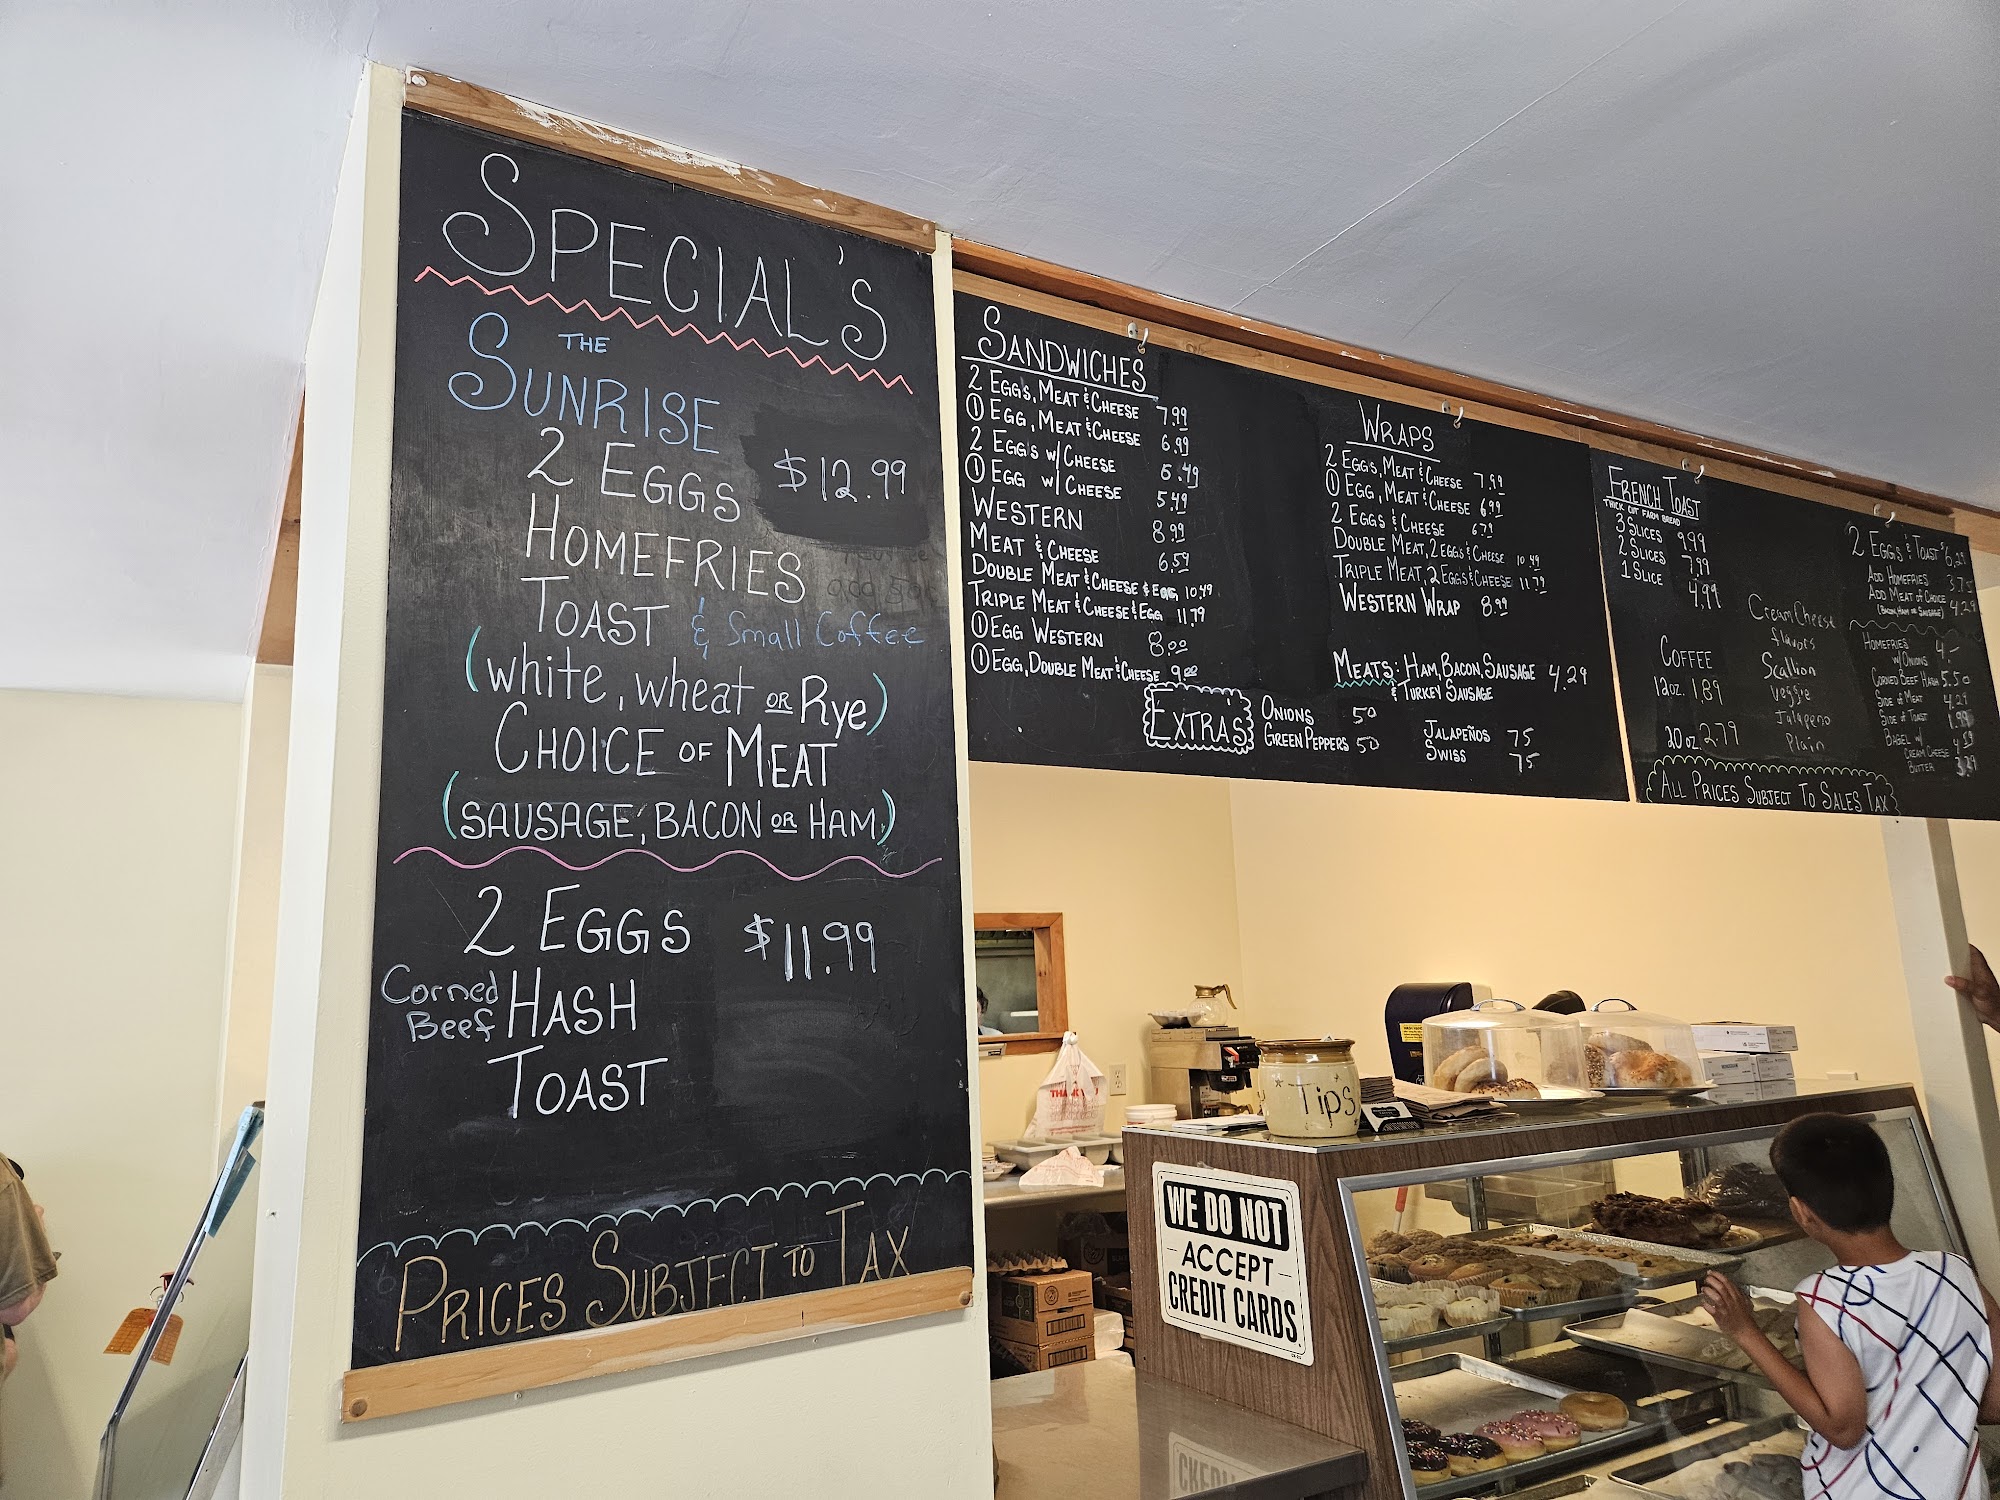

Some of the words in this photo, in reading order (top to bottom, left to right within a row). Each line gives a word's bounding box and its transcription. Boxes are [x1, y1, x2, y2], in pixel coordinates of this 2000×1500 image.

[443, 153, 887, 361] SPECIAL'S
[558, 333, 610, 353] THE
[978, 306, 1146, 393] SANDWICHES
[448, 312, 721, 454] SUNRISE
[968, 364, 982, 390] 2
[1039, 379, 1080, 407] MEAT
[1091, 391, 1139, 419] CHEESE
[1156, 406, 1188, 431] 7.99
[1039, 409, 1082, 436] MEAT
[1092, 421, 1141, 447] CHEESE
[1162, 434, 1188, 456] 6.99
[1358, 399, 1434, 452] WRAPS
[970, 425, 982, 451] 2
[1064, 444, 1116, 473] CHEESE
[1325, 444, 1337, 467] 2
[1383, 455, 1414, 481] MEAT
[1426, 465, 1463, 490] CHEESE
[527, 427, 574, 486] 2
[600, 442, 741, 523] EGGS
[774, 448, 907, 502] $12.99
[991, 459, 1026, 487] EGG
[1065, 471, 1122, 500] CHEESE
[1156, 491, 1188, 514] 5.49
[1607, 466, 1662, 509] FRENCH
[972, 486, 1083, 531] WESTERN
[1153, 520, 1185, 543] 8.99
[1384, 480, 1419, 505] MEAT
[1429, 490, 1471, 515] CHEESE
[1480, 498, 1503, 518] 6.99
[1603, 499, 1625, 511] THICK
[1661, 515, 1681, 526] BREAD
[1663, 476, 1700, 518] TOAST
[1331, 502, 1342, 523] 2
[1349, 504, 1385, 529] EGGS
[1401, 513, 1445, 536] CHEESE
[1616, 513, 1625, 532] 3
[1627, 516, 1663, 543] SLICES
[1677, 531, 1706, 553] 9.99
[525, 493, 805, 604] HOMEFRIES
[970, 521, 1025, 557] MEAT
[1047, 540, 1099, 564] CHEESE
[1333, 526, 1385, 552] DOUBLE
[1430, 538, 1438, 558] 2
[1473, 545, 1505, 564] CHEESE
[1618, 534, 1628, 555] 2
[1630, 537, 1666, 565] SLICES
[1681, 555, 1710, 577] 7.99
[1849, 525, 1865, 557] 2
[1869, 530, 1903, 562] EGGS
[1912, 535, 1939, 561] TOAST
[972, 553, 1033, 583] DOUBLE
[1042, 561, 1080, 587] MEAT
[1091, 571, 1139, 596] CHEESE
[1185, 584, 1213, 600] 10.49
[1333, 554, 1382, 579] TRIPLE
[1427, 566, 1440, 584] 2
[1474, 569, 1512, 588] CHEESE
[1621, 560, 1631, 578] 1
[1633, 561, 1663, 585] SLICE
[1868, 565, 1884, 583] ADD
[1886, 566, 1929, 586] HOMEFRIES
[520, 575, 670, 647] TOAST
[727, 612, 800, 650] Small
[818, 611, 928, 648] Coffee
[968, 580, 1025, 610] TRIPLE
[1032, 588, 1070, 615] MEAT
[1083, 597, 1130, 620] CHEESE
[1139, 602, 1163, 622] EGG
[1177, 606, 1206, 627] 11.79
[1339, 582, 1417, 613] WESTERN
[1420, 587, 1461, 616] WRAP
[1481, 595, 1508, 616] 8.99
[1748, 593, 1794, 624] Cream
[1794, 600, 1836, 628] Cheese
[1869, 584, 1887, 600] ADD
[1889, 587, 1913, 602] MEAT
[991, 615, 1023, 641] EGG
[1031, 617, 1103, 648] WESTERN
[1148, 631, 1188, 656] 8.00
[1660, 634, 1712, 669] COFFEE
[1771, 627, 1816, 651] flavors
[1862, 632, 1909, 650] HOMEFRIES
[635, 657, 754, 715] wheat
[766, 692, 792, 712] OR
[1029, 651, 1077, 678] DOUBLE
[1082, 656, 1113, 680] MEAT
[1121, 662, 1160, 683] CHEESE
[1483, 653, 1535, 681] SAUSAGE
[1548, 664, 1588, 693] 4.29
[1762, 651, 1816, 679] Scallion
[1261, 695, 1314, 725] ONIONS
[1352, 707, 1377, 724] 50
[1398, 678, 1441, 701] TURKEY
[1445, 679, 1493, 702] SAUSAGE
[1691, 678, 1723, 705] 1.89
[495, 701, 664, 776] CHOICE
[679, 741, 711, 762] OF
[727, 724, 838, 788] MEAT
[1264, 721, 1303, 748] GREEN
[1305, 726, 1349, 751] PEPPERS
[1356, 736, 1380, 753] 50
[1424, 719, 1491, 743] JALAPEÑOS
[1507, 727, 1535, 747] 75
[1665, 725, 1682, 749] 20
[1700, 720, 1739, 747] 2.79
[1786, 733, 1825, 752] Plain
[1425, 739, 1466, 763] SWISS
[1509, 752, 1541, 773] 75
[1661, 770, 1686, 799] ALL
[1691, 770, 1739, 803] PRICES
[1745, 775, 1792, 806] SUBJECT
[1799, 782, 1816, 808] TO
[1820, 781, 1862, 812] SALES
[1863, 782, 1889, 812] TAX
[655, 800, 762, 840] BACON
[772, 813, 798, 832] OR
[464, 886, 515, 956] 2
[539, 884, 691, 955] EGGS
[743, 913, 877, 982] $11.99
[380, 963, 499, 1005] Corned
[406, 1008, 496, 1042] Beef
[507, 966, 638, 1039] HASH
[487, 1045, 669, 1119] TOAST
[1288, 1082, 1356, 1128] Tips
[1167, 1184, 1199, 1229] WE
[1204, 1191, 1233, 1235] DO
[1240, 1197, 1283, 1246] NOT
[395, 1255, 567, 1352] PRICES
[585, 1230, 779, 1329] SUBJECT
[783, 1245, 815, 1278] TO
[826, 1201, 910, 1286] TAX
[1181, 1240, 1274, 1286] ACCEPT
[1168, 1271, 1226, 1323] CREDIT
[1233, 1287, 1298, 1343] CARDS
